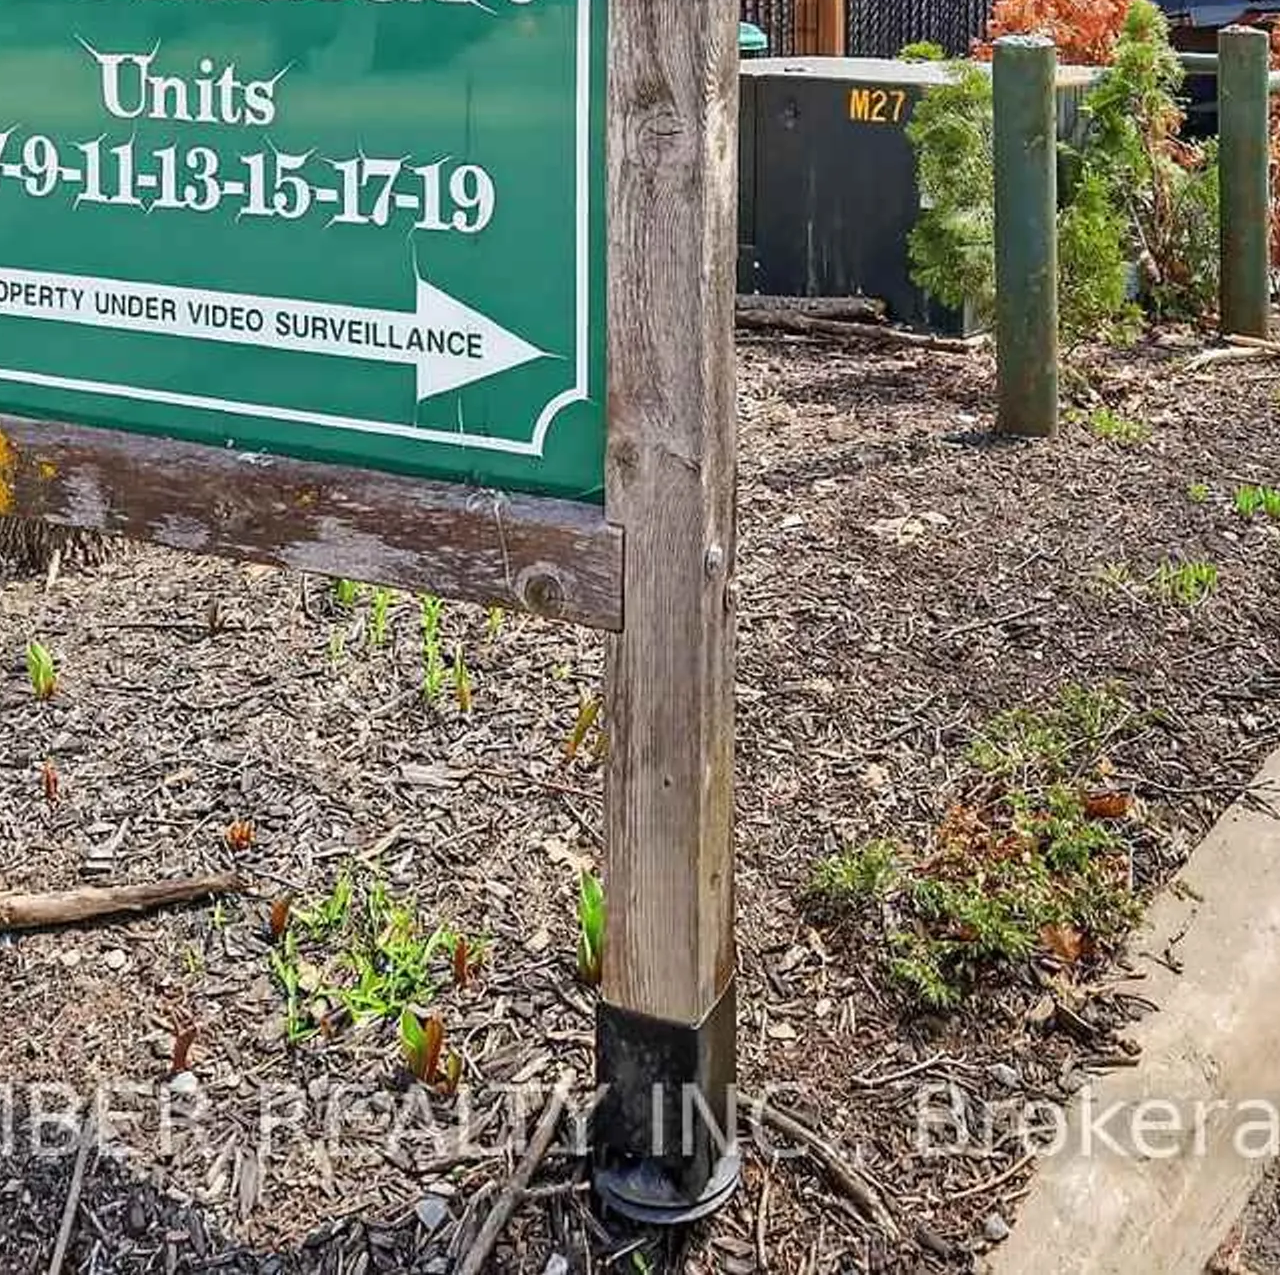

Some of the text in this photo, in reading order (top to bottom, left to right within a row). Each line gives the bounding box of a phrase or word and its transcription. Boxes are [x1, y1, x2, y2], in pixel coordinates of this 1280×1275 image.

[96, 50, 279, 125] Units
[850, 88, 906, 122] M27
[94, 291, 177, 322] UNDER
[187, 301, 264, 333] VIDEO
[275, 310, 484, 359] SURVEILLANCE
